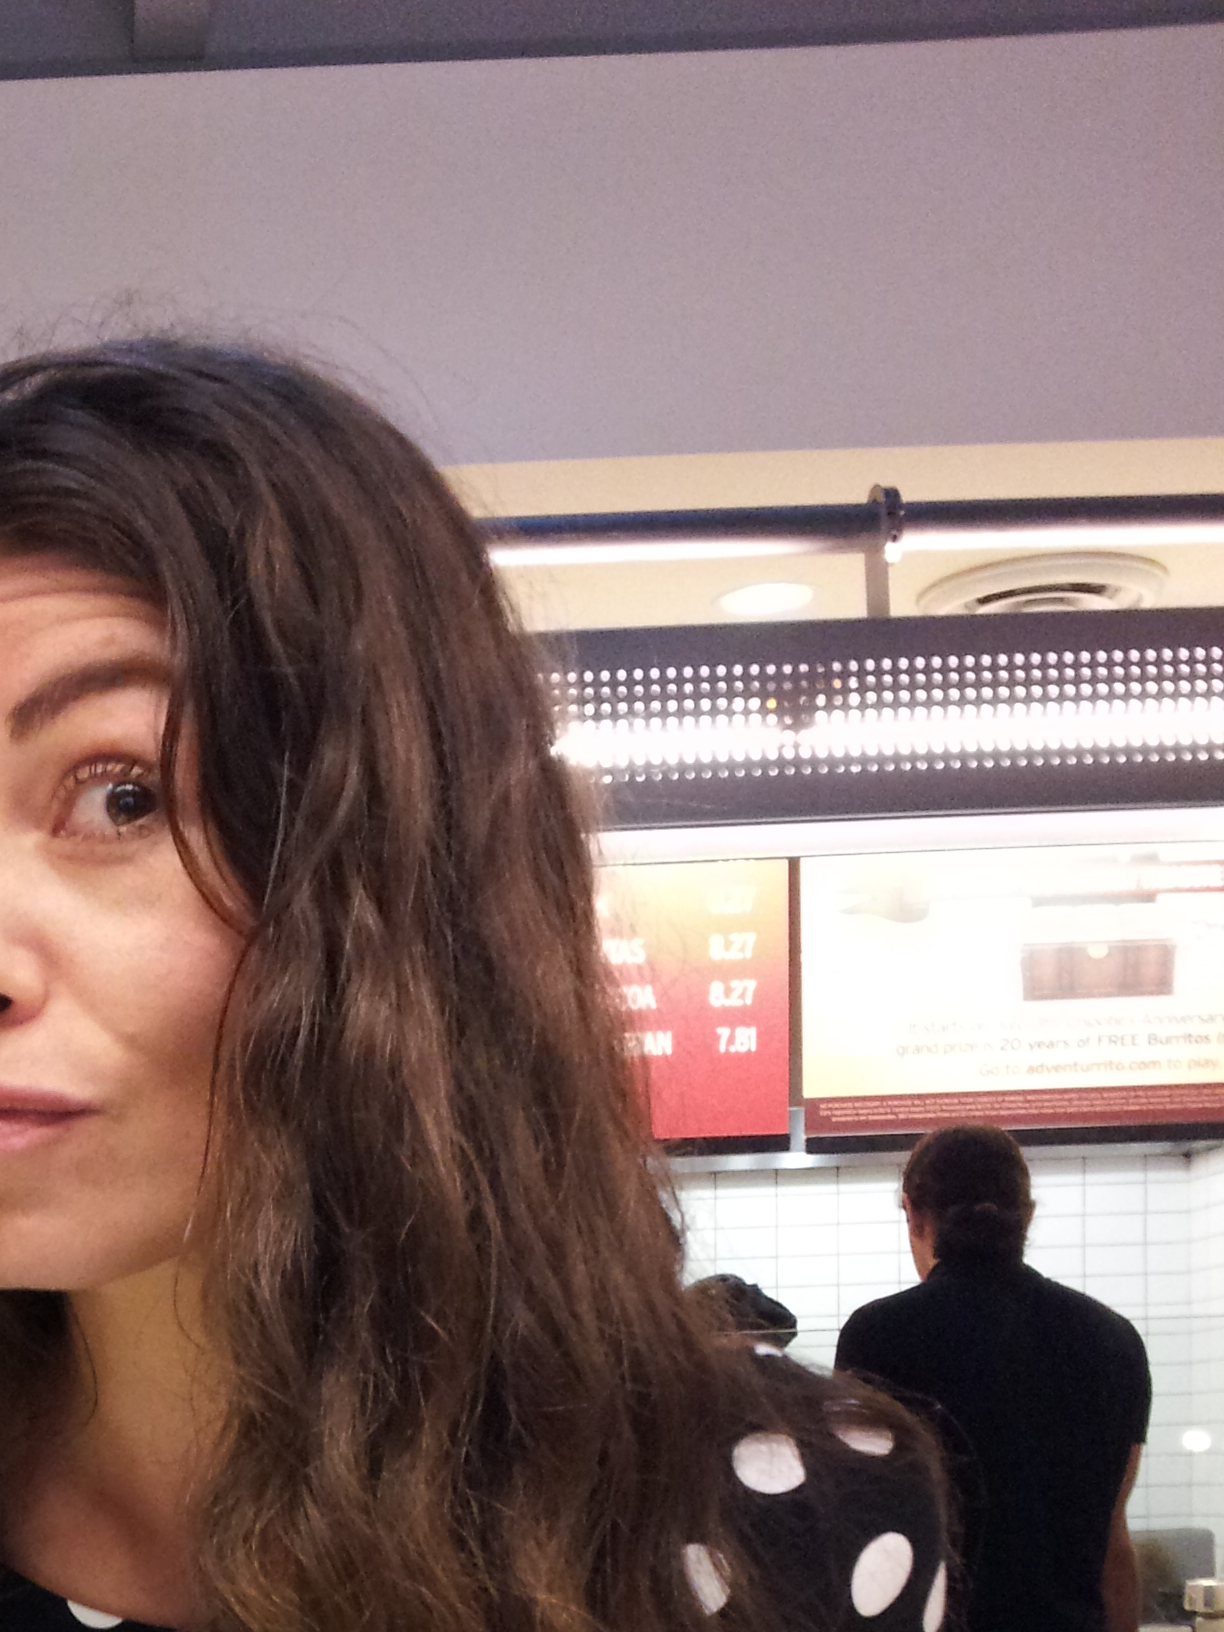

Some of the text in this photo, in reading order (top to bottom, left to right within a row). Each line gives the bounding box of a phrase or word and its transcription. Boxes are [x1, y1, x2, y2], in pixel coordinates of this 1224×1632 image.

[708, 932, 757, 960] 8.27
[709, 978, 757, 1007] 8.27
[716, 1026, 757, 1053] 7.81
[896, 1042, 939, 1059] grand
[999, 1037, 1021, 1051] 20
[1028, 1037, 1070, 1052] years
[1076, 1036, 1090, 1048] of
[1097, 1033, 1139, 1047] FREE
[1147, 1032, 1212, 1046] Burritos
[979, 1063, 1001, 1077] Go
[1005, 1062, 1021, 1075] to
[1026, 1058, 1163, 1076] adventurrito.com
[1166, 1057, 1182, 1070] to
